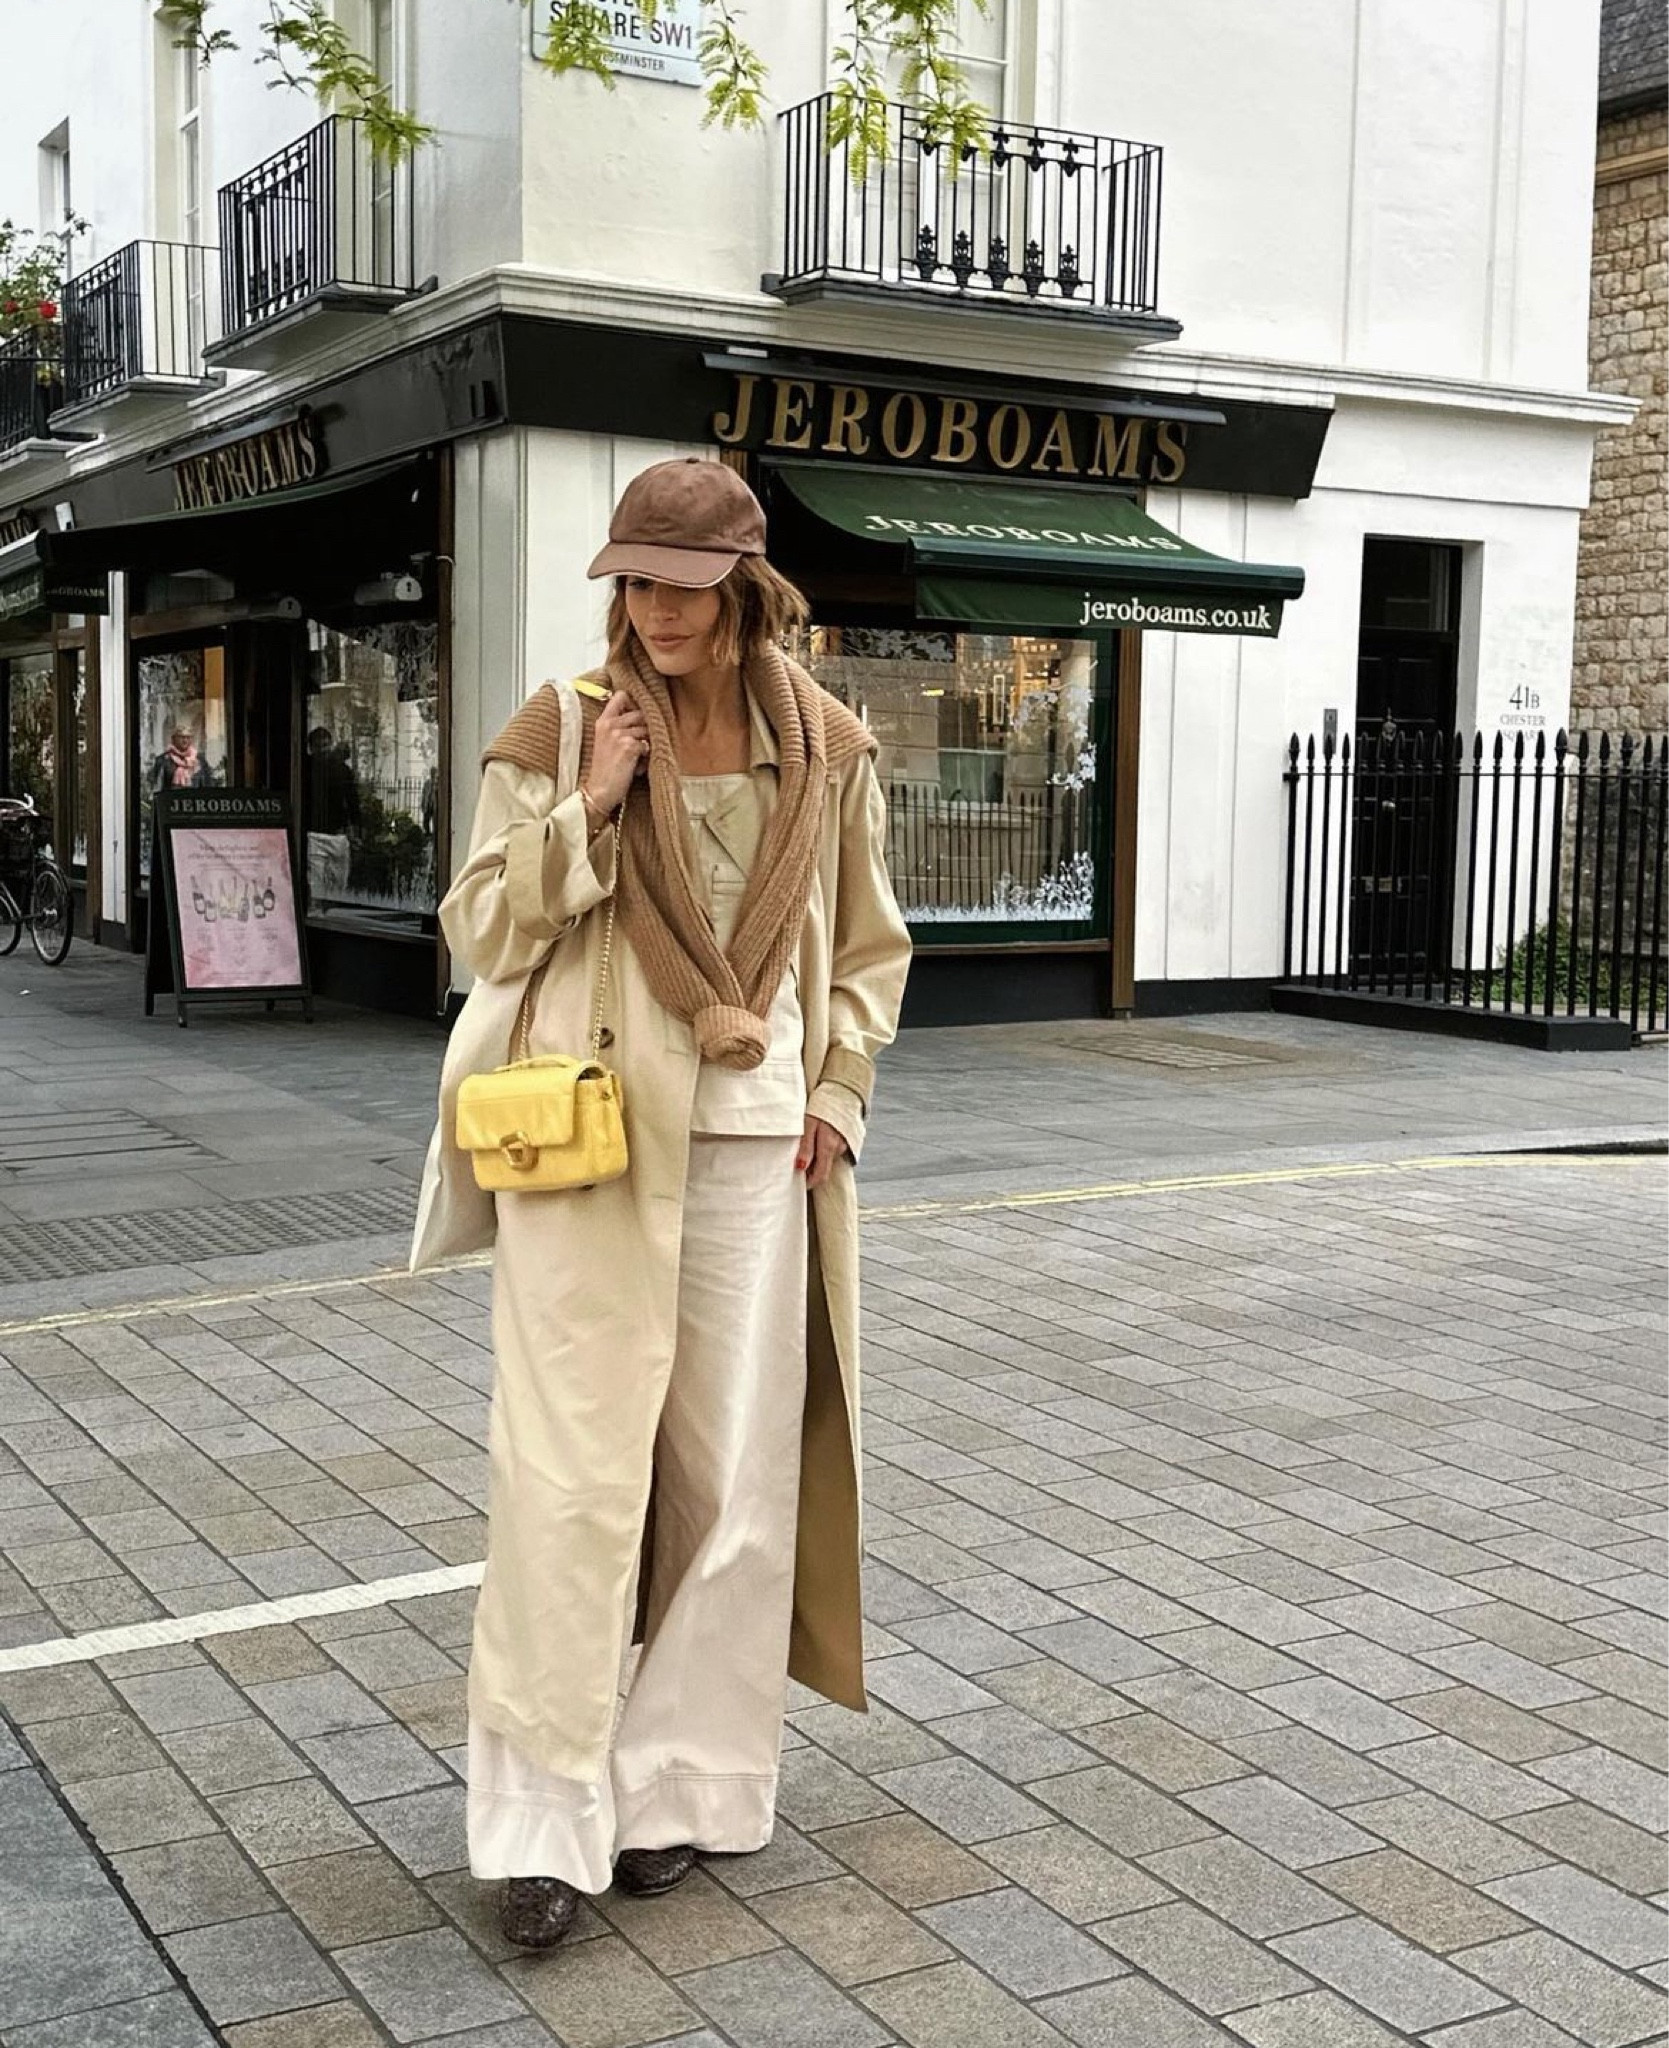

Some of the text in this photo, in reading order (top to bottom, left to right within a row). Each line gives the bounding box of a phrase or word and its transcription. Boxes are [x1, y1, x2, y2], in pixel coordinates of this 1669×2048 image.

[550, 0, 691, 49] SUARE SW1
[713, 374, 1189, 482] JEROBOAMS
[864, 515, 1182, 551] JEROBOAMS
[1080, 592, 1272, 631] jeroboams.co.uk
[1509, 683, 1540, 710] 41B
[1500, 714, 1546, 726] CHESTER
[170, 798, 282, 814] JEROBOAMS
